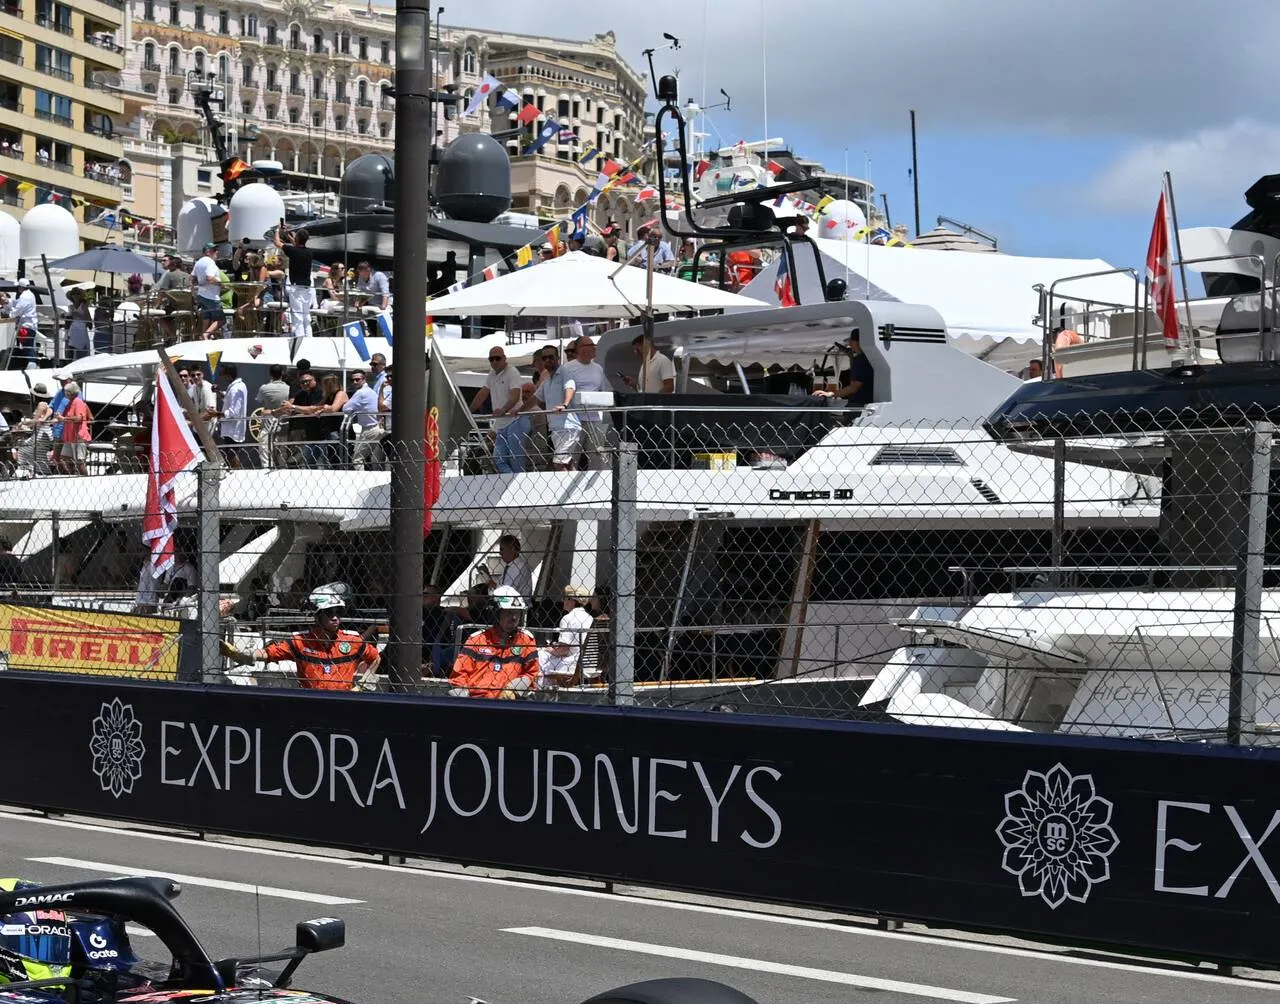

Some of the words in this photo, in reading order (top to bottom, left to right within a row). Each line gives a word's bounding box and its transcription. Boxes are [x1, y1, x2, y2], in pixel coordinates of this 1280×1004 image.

[10, 618, 164, 667] PIRELLI
[160, 720, 406, 809] EXPLORA
[420, 741, 782, 849] JOURNEYS
[15, 892, 75, 907] DAMAC
[89, 949, 118, 959] Gate
